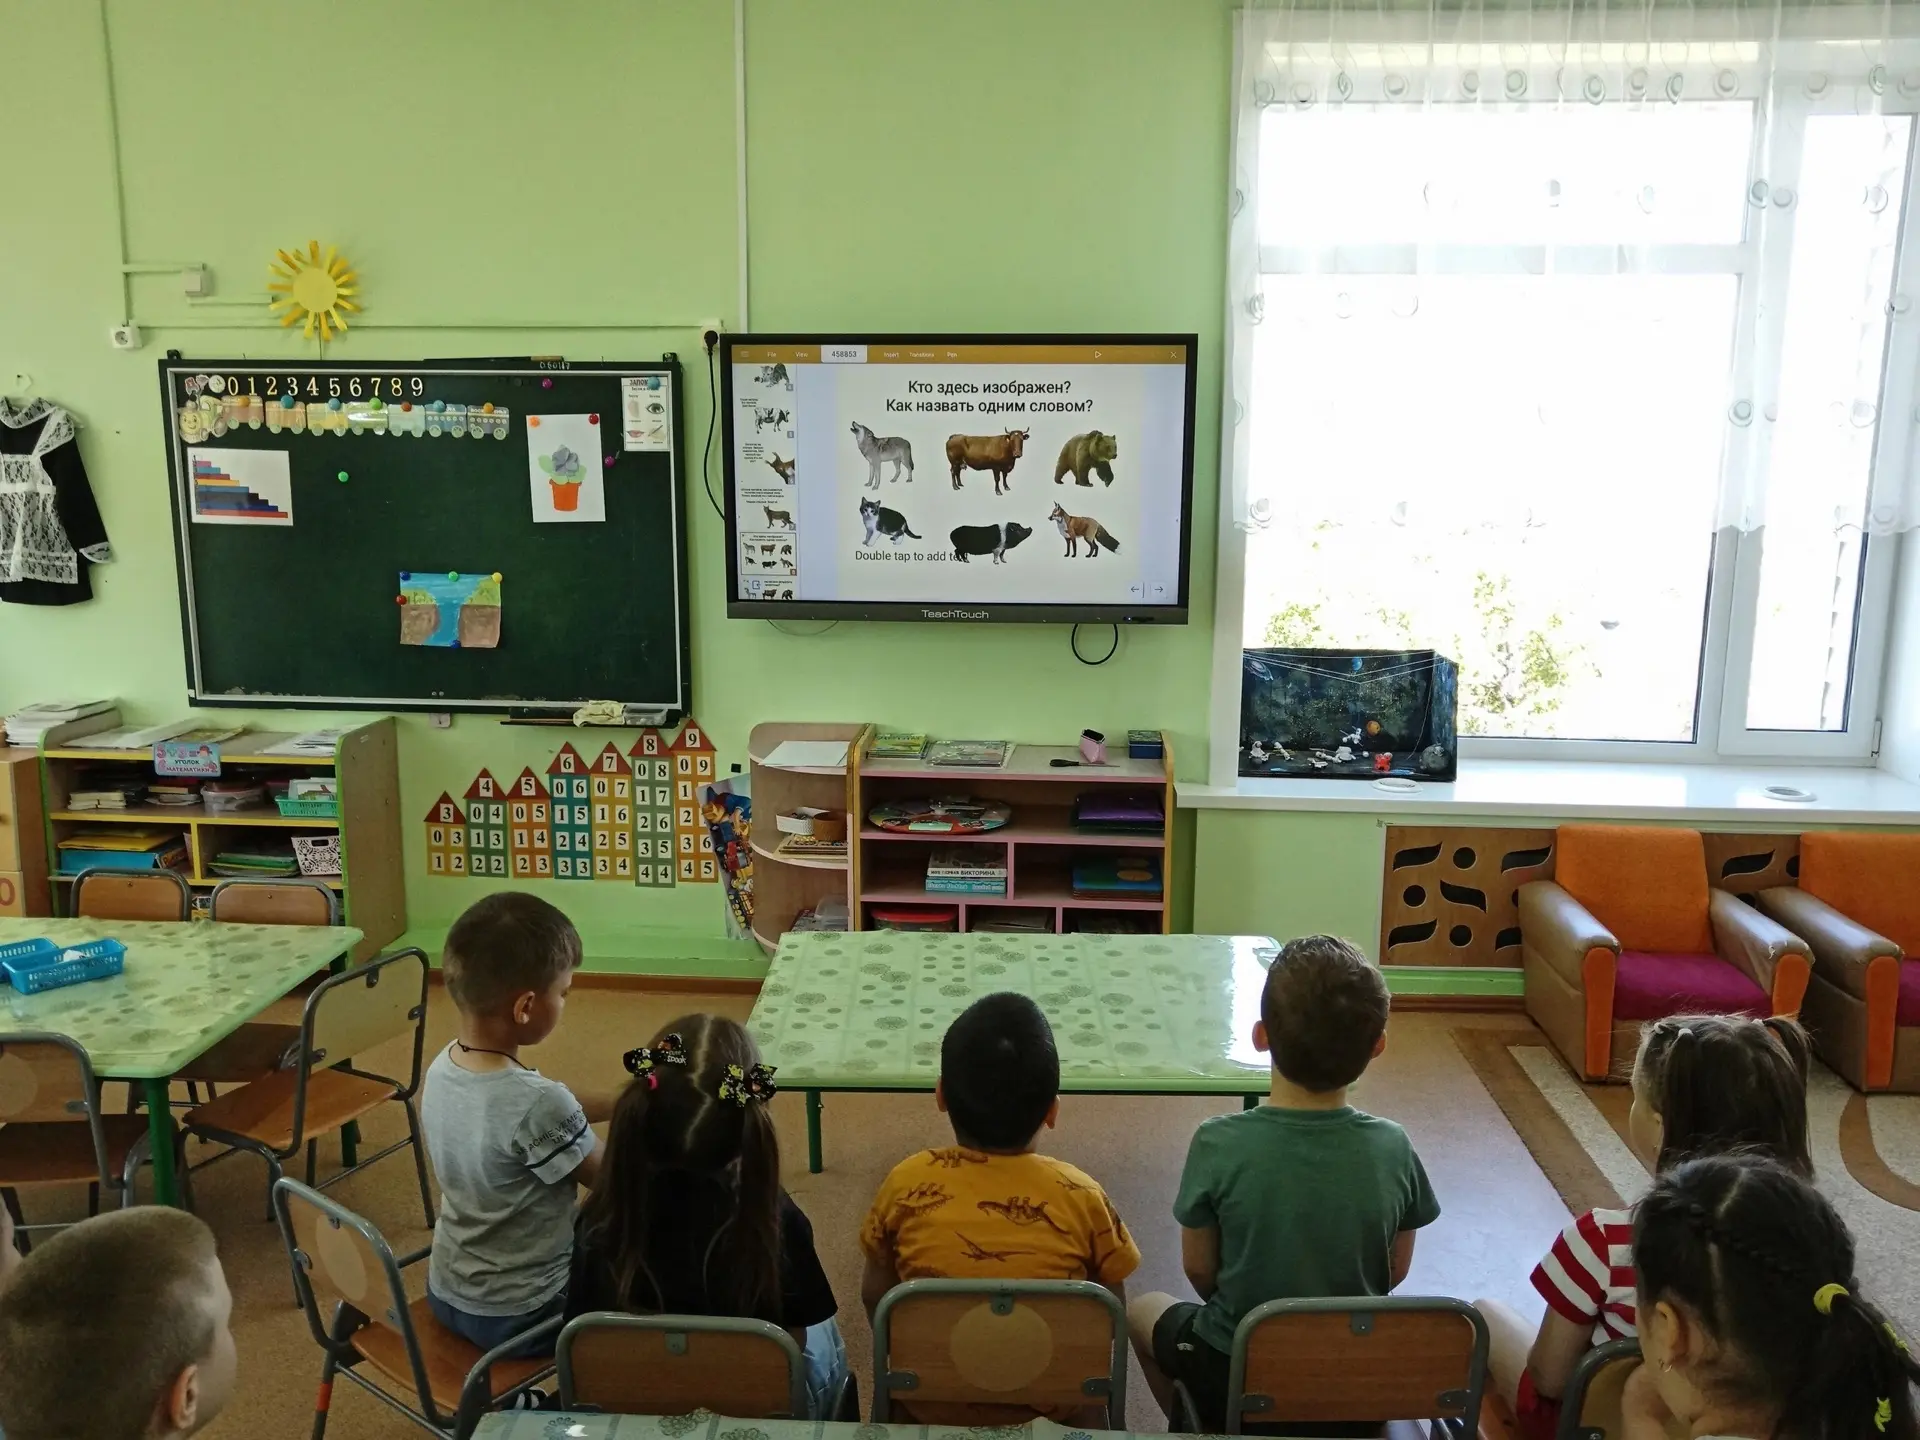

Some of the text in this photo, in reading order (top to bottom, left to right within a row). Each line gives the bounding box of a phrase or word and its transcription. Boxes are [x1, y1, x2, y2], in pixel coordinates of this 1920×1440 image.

[831, 350, 857, 358] 458853
[908, 379, 1072, 397] Кто здесь изображен?
[886, 398, 1094, 414] Как назвать одним словом?
[855, 550, 892, 561] Double
[894, 552, 911, 563] tap
[913, 551, 924, 561] to
[926, 551, 946, 562] add
[921, 609, 989, 619] TeachTouch
[646, 738, 655, 752] 8
[688, 733, 698, 746] 9
[562, 756, 572, 770] 6
[605, 755, 615, 769] 7
[680, 758, 709, 772] 0 9
[637, 763, 667, 778] 0 8
[481, 779, 491, 793] 4
[523, 779, 533, 793] 5
[555, 781, 585, 795] 0 6
[596, 781, 626, 795] 0 7
[681, 784, 688, 798] 1
[639, 789, 667, 803] 1 7
[442, 806, 452, 820] 3
[472, 806, 501, 820] 0 4
[515, 805, 545, 820] 0 5
[558, 807, 586, 821] 1 5
[599, 807, 627, 821] 1 6
[683, 809, 692, 823] 2
[640, 815, 669, 829] 2 6
[433, 830, 462, 844] 0 3
[474, 832, 501, 845] 1 3
[517, 830, 546, 845] 1 4
[559, 834, 587, 848] 2 4
[599, 832, 627, 847] 2 5
[684, 836, 712, 849] 3 6
[642, 840, 669, 854] 3 5
[435, 855, 463, 869] 1 2
[475, 857, 502, 871] 2 2
[519, 857, 548, 870] 2 3
[561, 860, 588, 873] 3 3
[600, 858, 628, 871] 3 4
[684, 861, 713, 875] 4 5
[641, 865, 669, 879] 4 4
